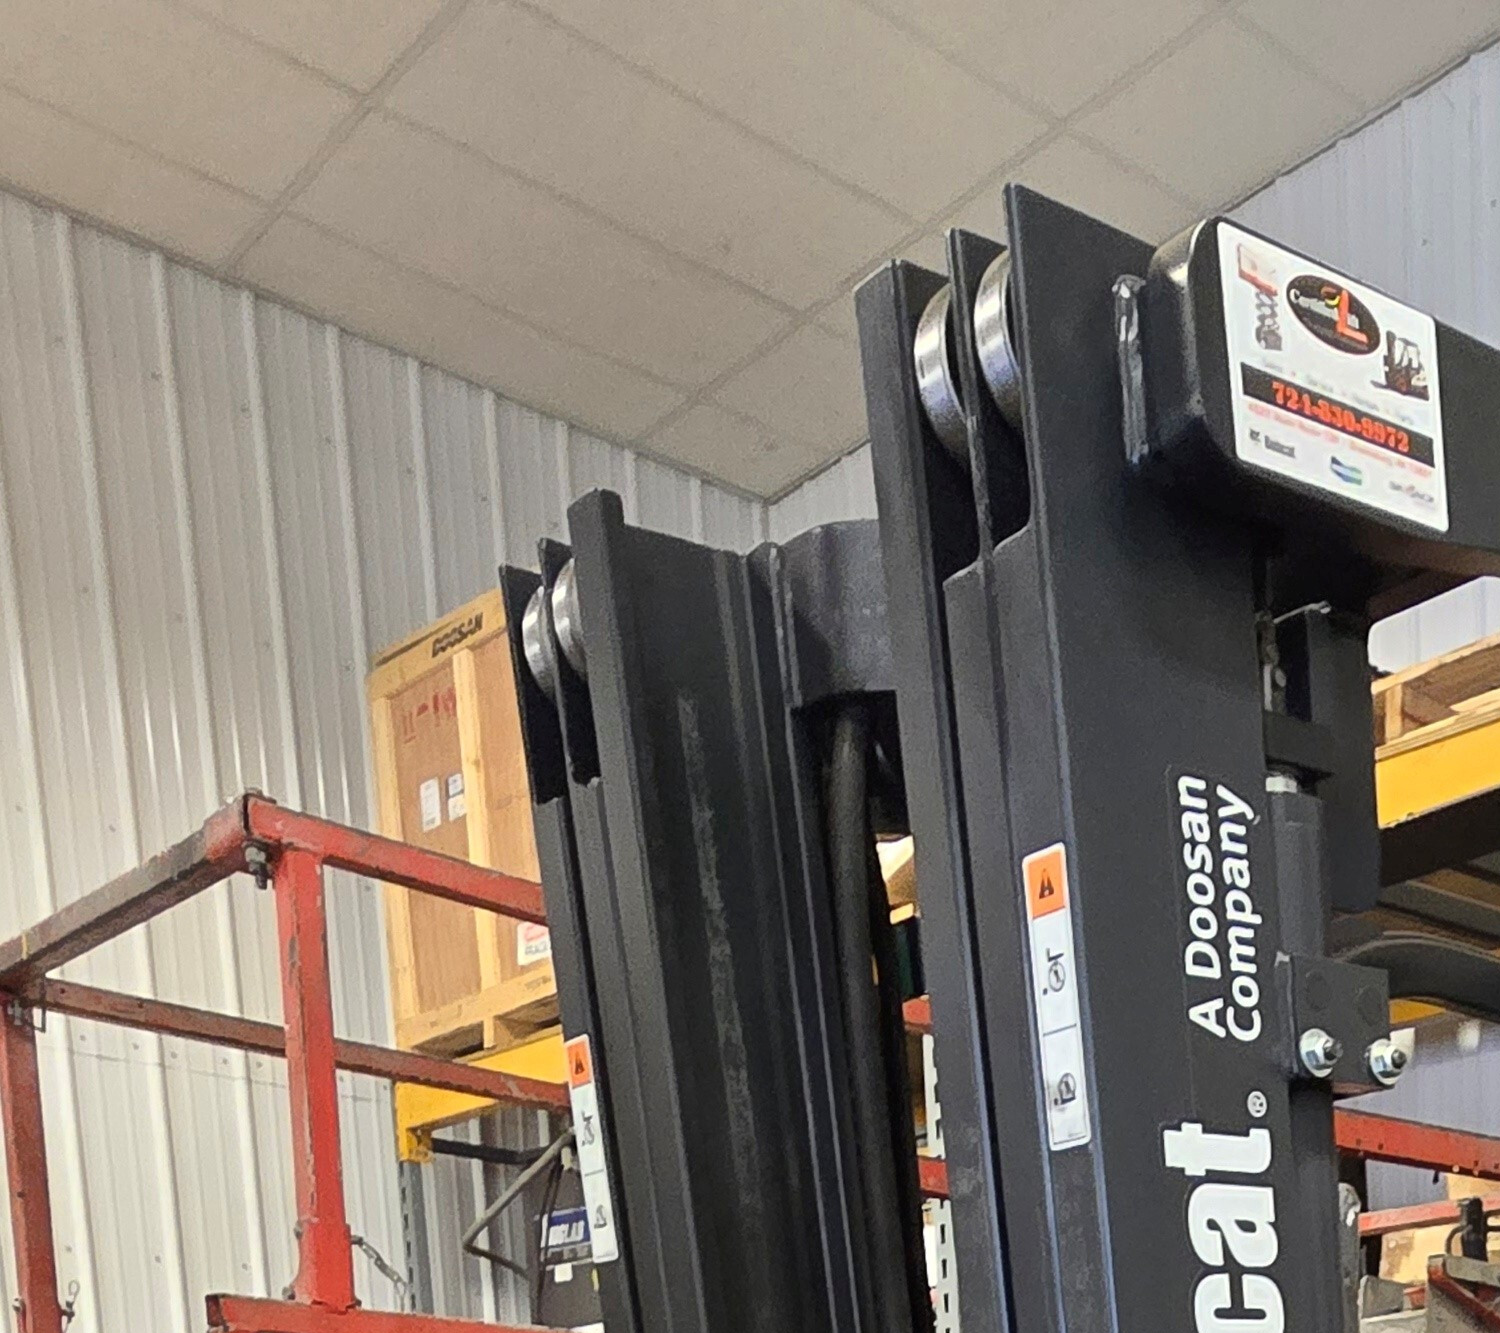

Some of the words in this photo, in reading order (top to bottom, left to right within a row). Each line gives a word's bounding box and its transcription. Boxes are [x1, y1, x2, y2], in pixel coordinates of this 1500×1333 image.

[432, 612, 484, 658] DOOSAN
[1177, 775, 1222, 980] Doosan
[1214, 784, 1264, 1043] Company
[1188, 997, 1227, 1039] A
